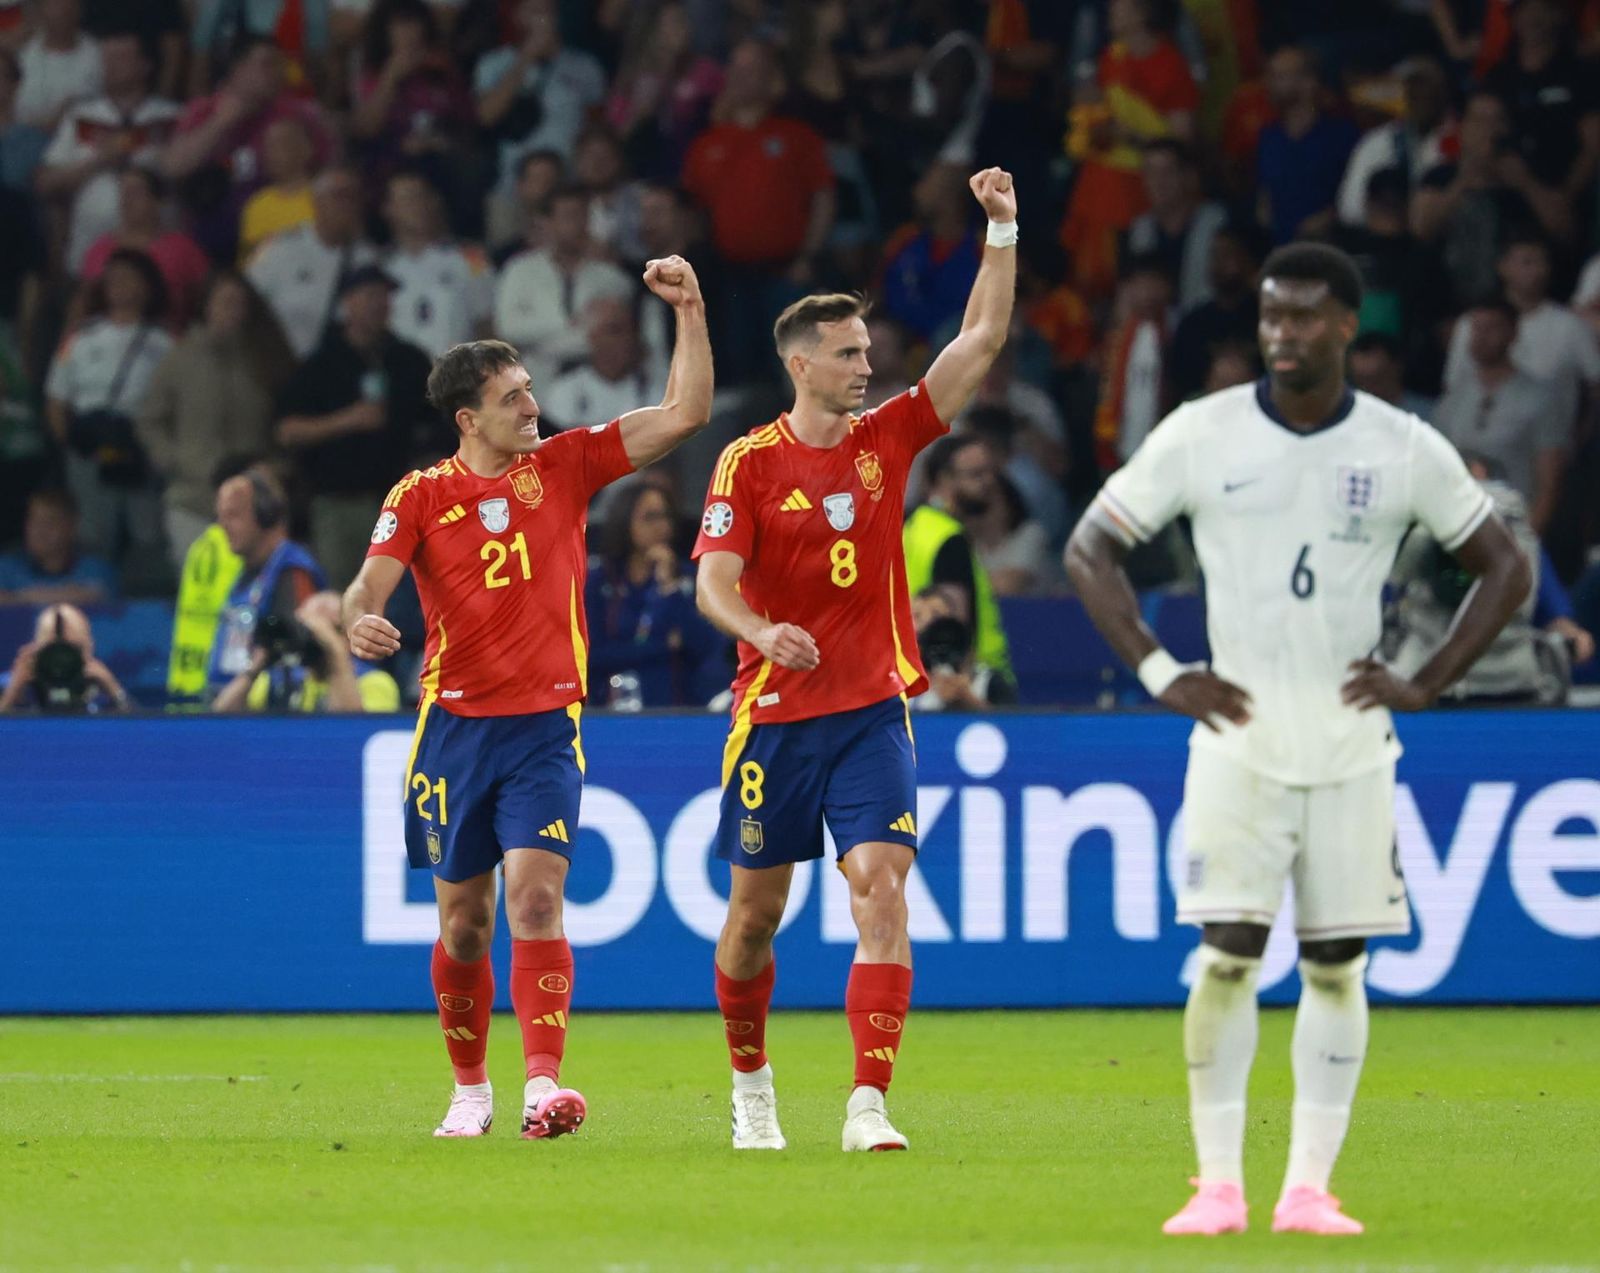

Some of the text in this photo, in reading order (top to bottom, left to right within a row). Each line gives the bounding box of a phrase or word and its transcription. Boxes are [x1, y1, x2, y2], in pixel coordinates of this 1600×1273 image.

[480, 532, 532, 589] 21
[829, 540, 858, 588] 8
[1291, 545, 1315, 600] 6
[411, 773, 448, 826] 21
[739, 760, 765, 810] 8
